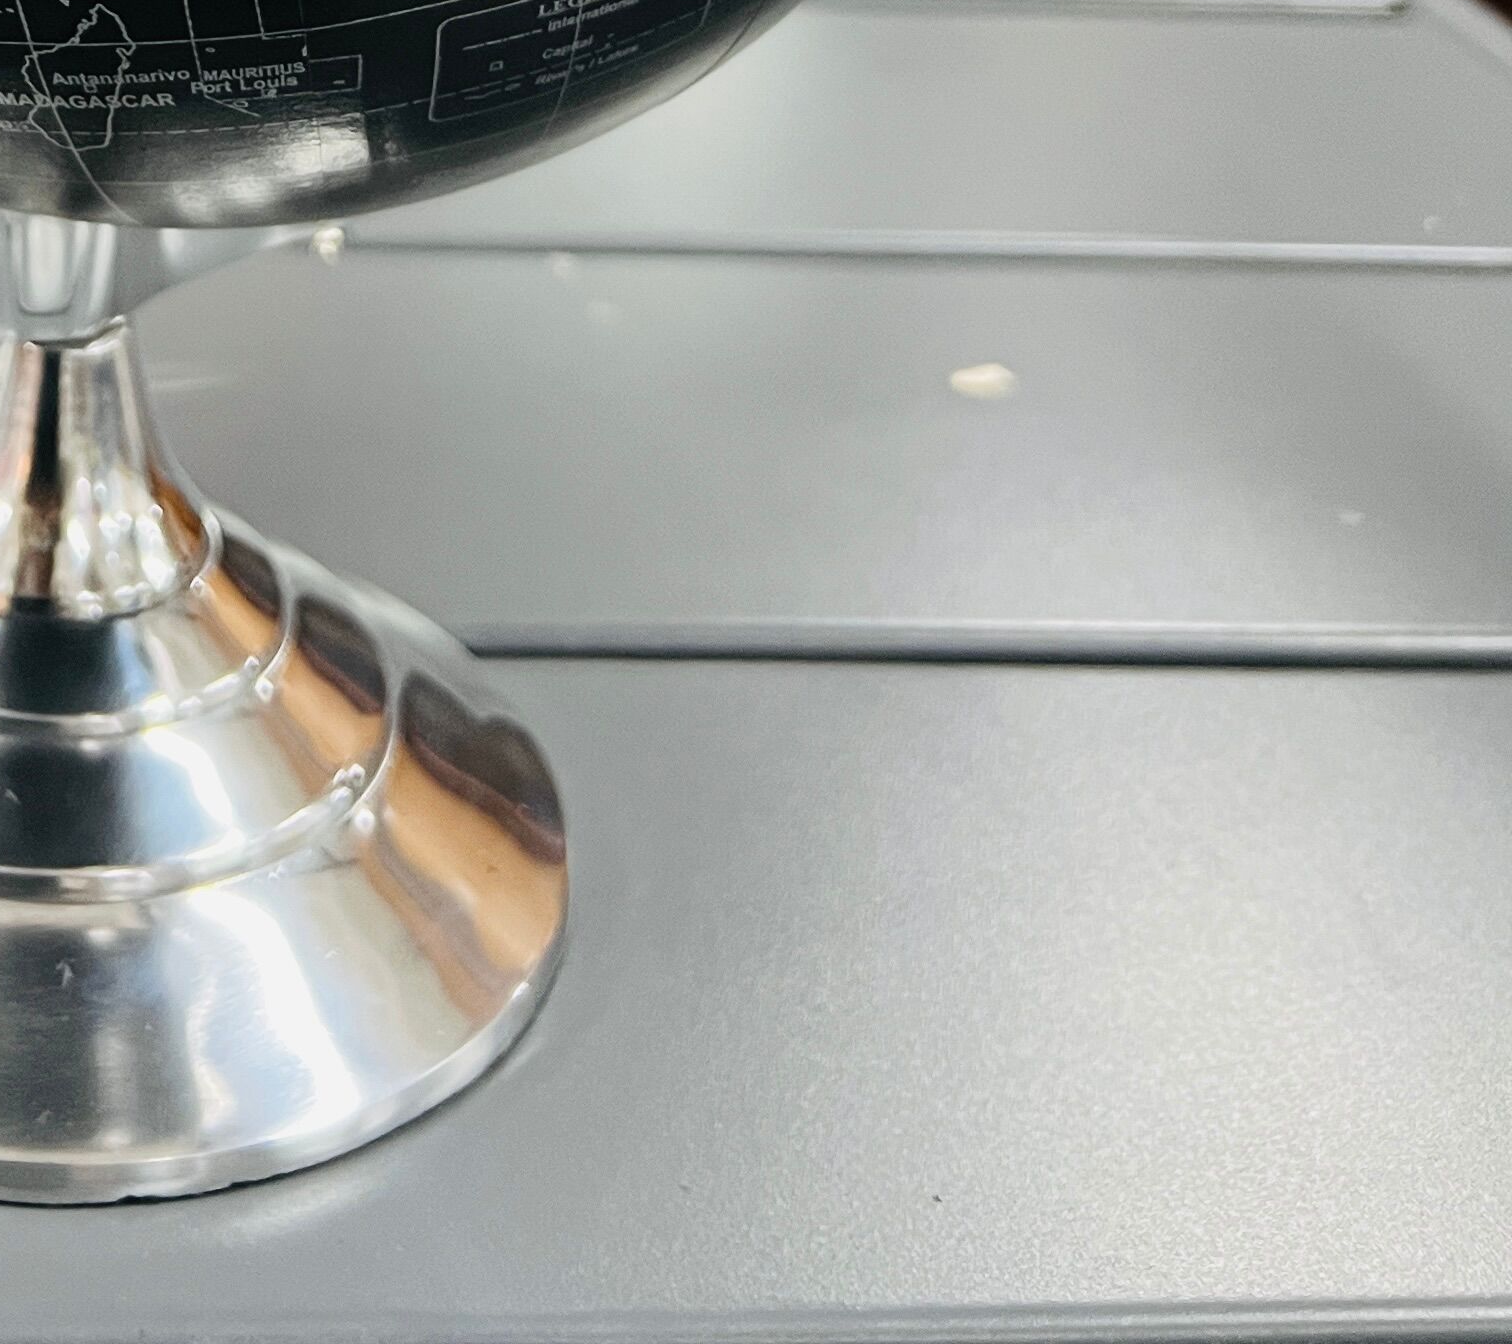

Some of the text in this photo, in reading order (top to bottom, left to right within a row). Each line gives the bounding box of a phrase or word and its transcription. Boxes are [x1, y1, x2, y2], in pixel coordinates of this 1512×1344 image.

[52, 68, 191, 86] Antananarivo
[203, 61, 306, 83] MAURITIUS
[190, 73, 299, 96] Port Louis
